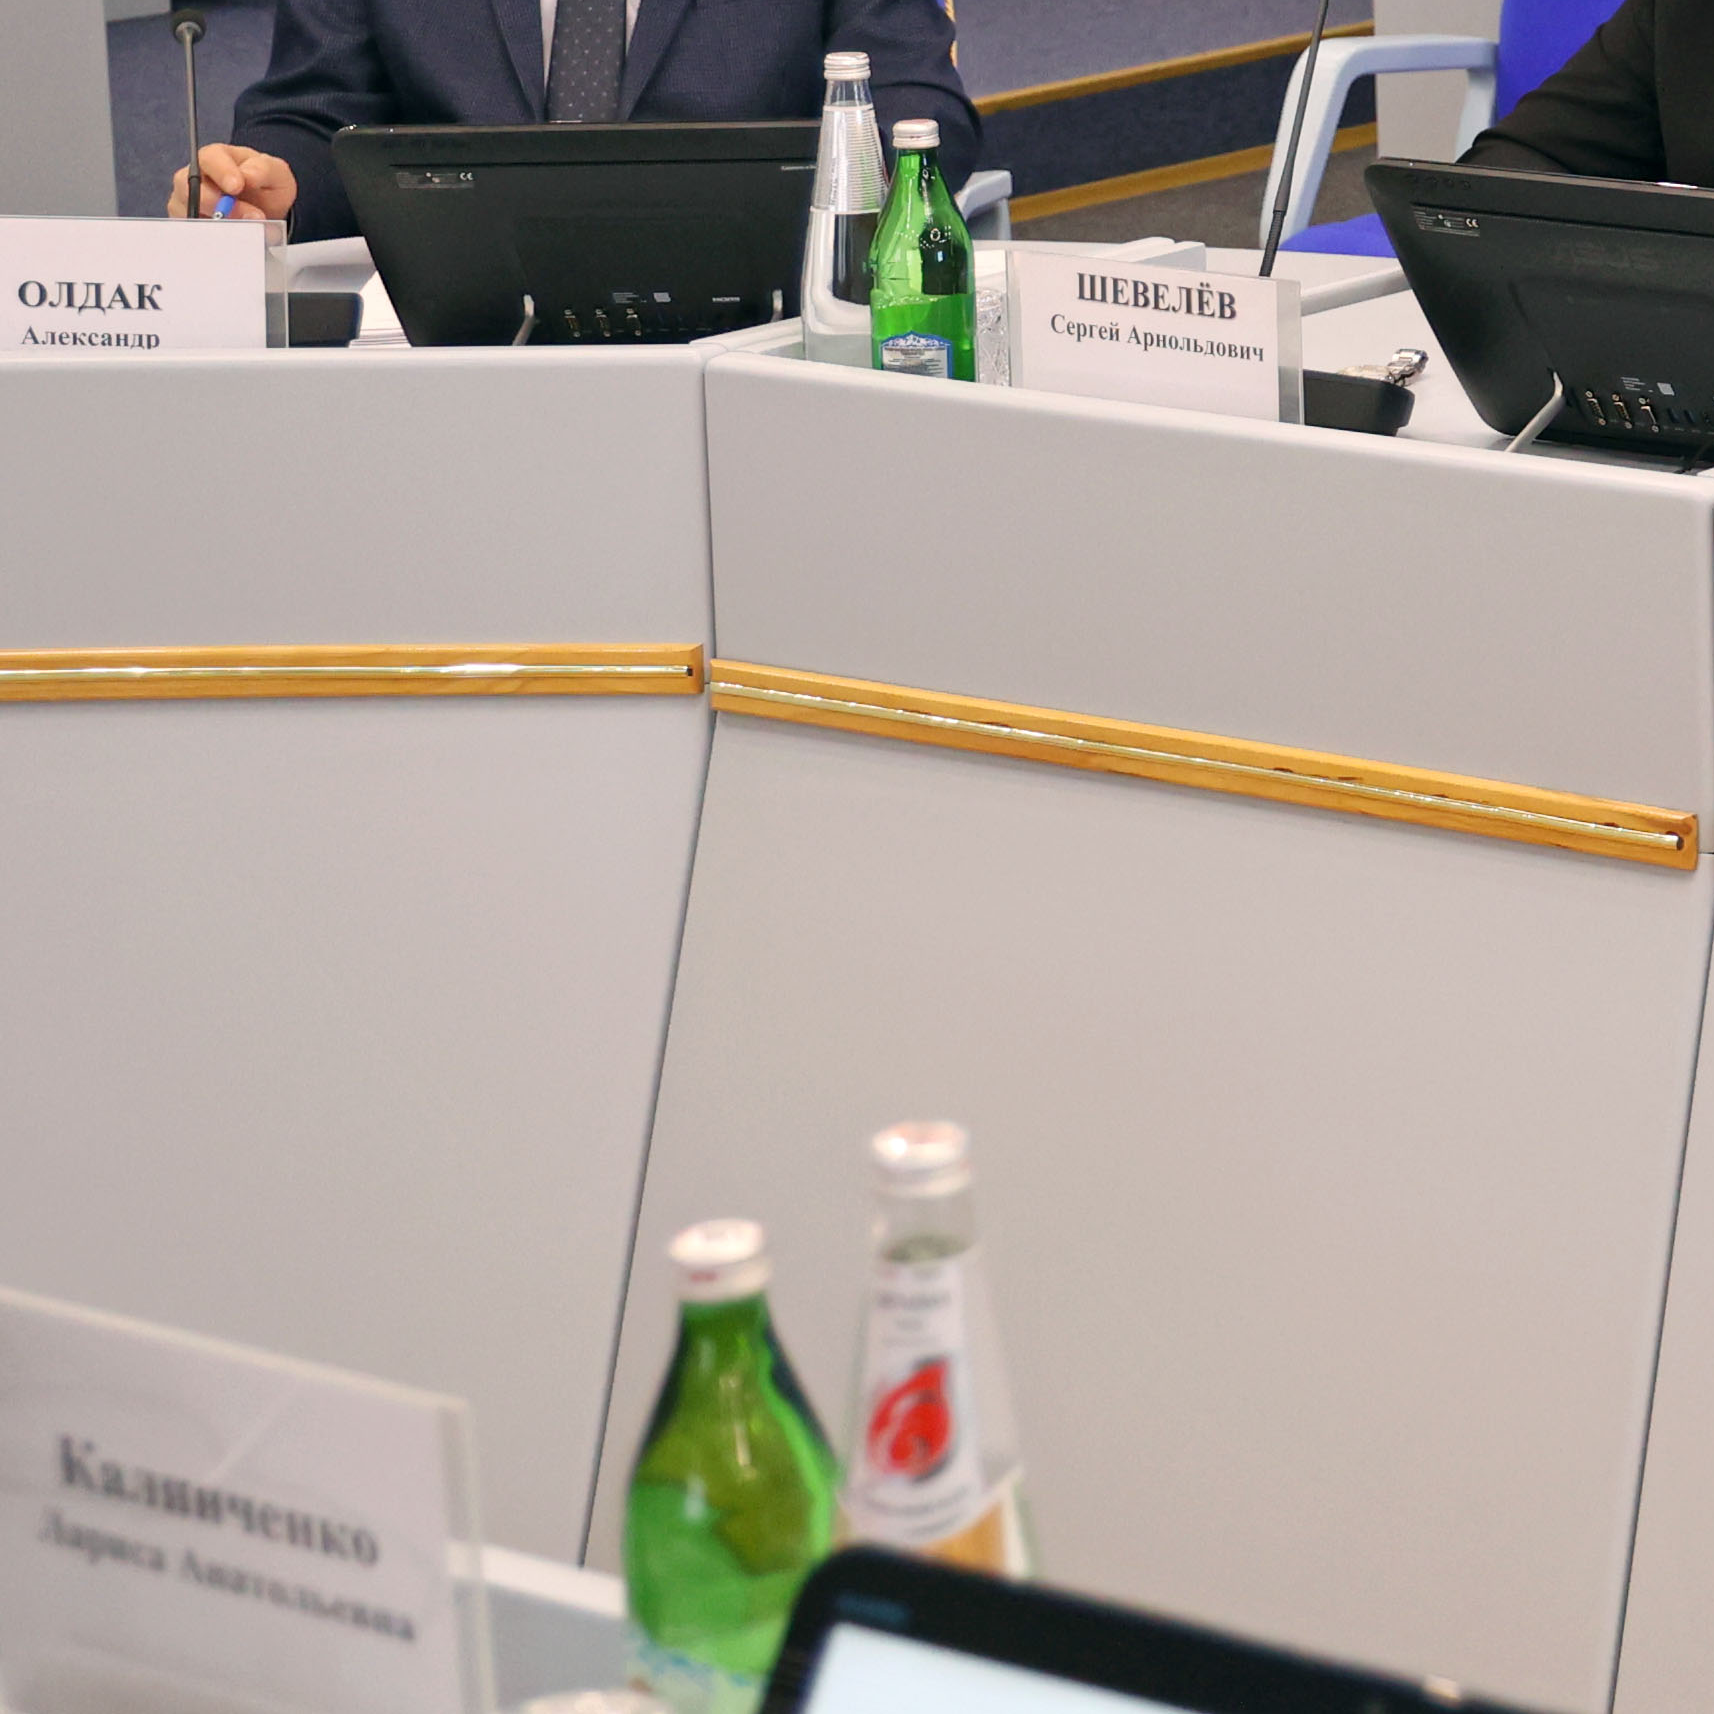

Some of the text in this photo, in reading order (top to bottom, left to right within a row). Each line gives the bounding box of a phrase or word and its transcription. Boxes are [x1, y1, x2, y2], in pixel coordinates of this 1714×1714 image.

[18, 280, 163, 315] ОЛДАК
[1076, 272, 1237, 320] ШЕВЕЛЁВ
[21, 325, 160, 350] Александр
[1050, 313, 1265, 363] Сергей Арнольдович
